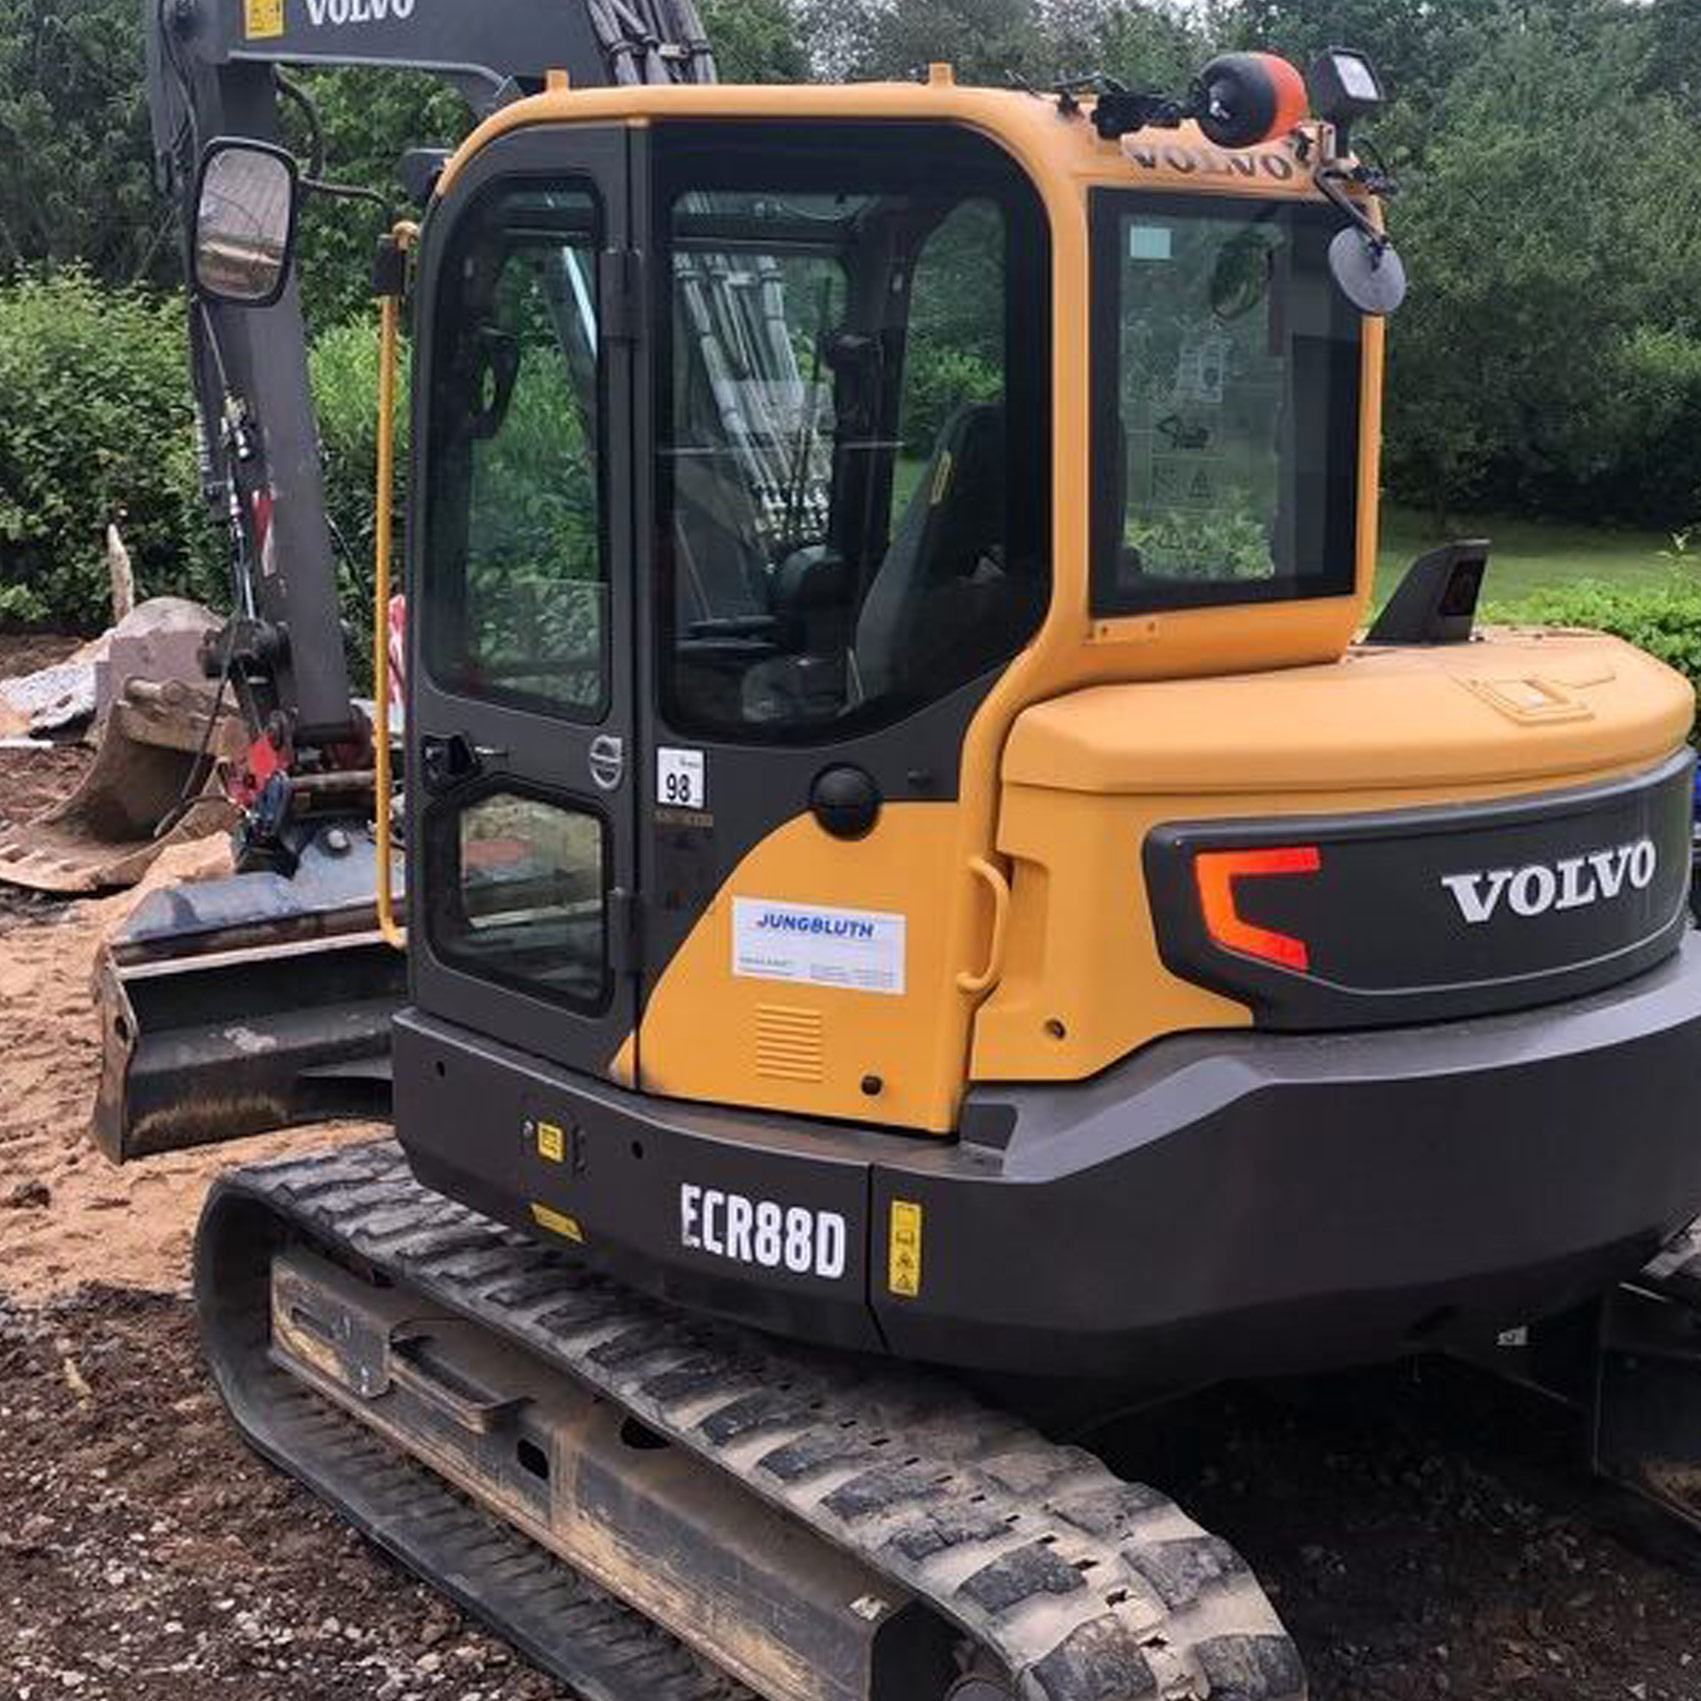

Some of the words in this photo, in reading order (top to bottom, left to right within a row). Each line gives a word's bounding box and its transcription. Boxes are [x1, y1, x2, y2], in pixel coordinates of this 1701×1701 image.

[305, 0, 415, 26] VOLVO
[665, 772, 691, 803] 98
[1441, 839, 1657, 924] VOLVO
[756, 913, 875, 938] JUNGBLUTH
[681, 1182, 846, 1280] ECR88D
